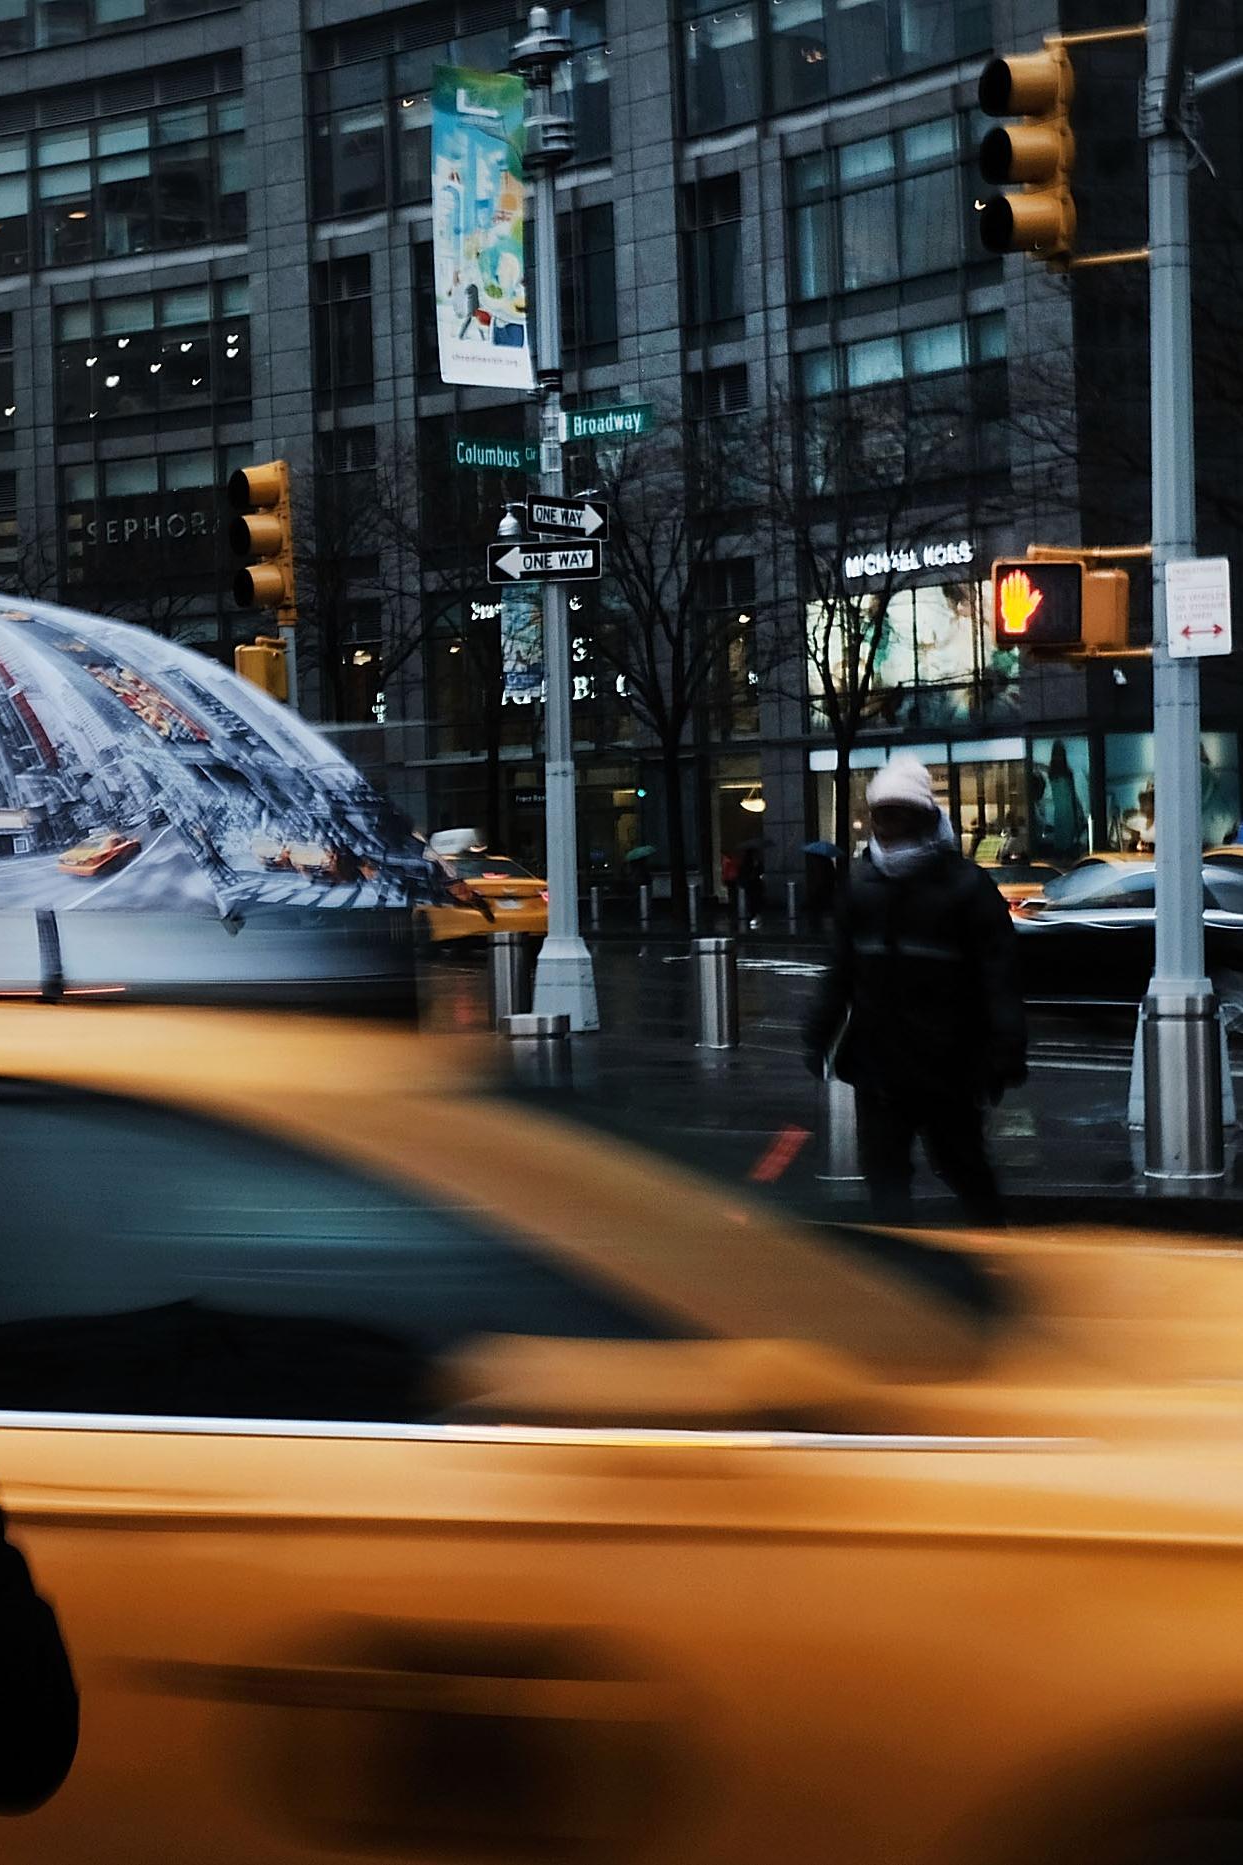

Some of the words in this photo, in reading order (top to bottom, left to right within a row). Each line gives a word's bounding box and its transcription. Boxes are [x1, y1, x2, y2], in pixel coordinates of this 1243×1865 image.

[573, 411, 641, 436] Broadway
[456, 441, 521, 469] Columbus
[535, 506, 557, 524] ONE
[560, 508, 583, 527] WAY
[523, 553, 553, 570] ONE
[558, 552, 587, 568] WAY
[923, 539, 974, 568] KORS
